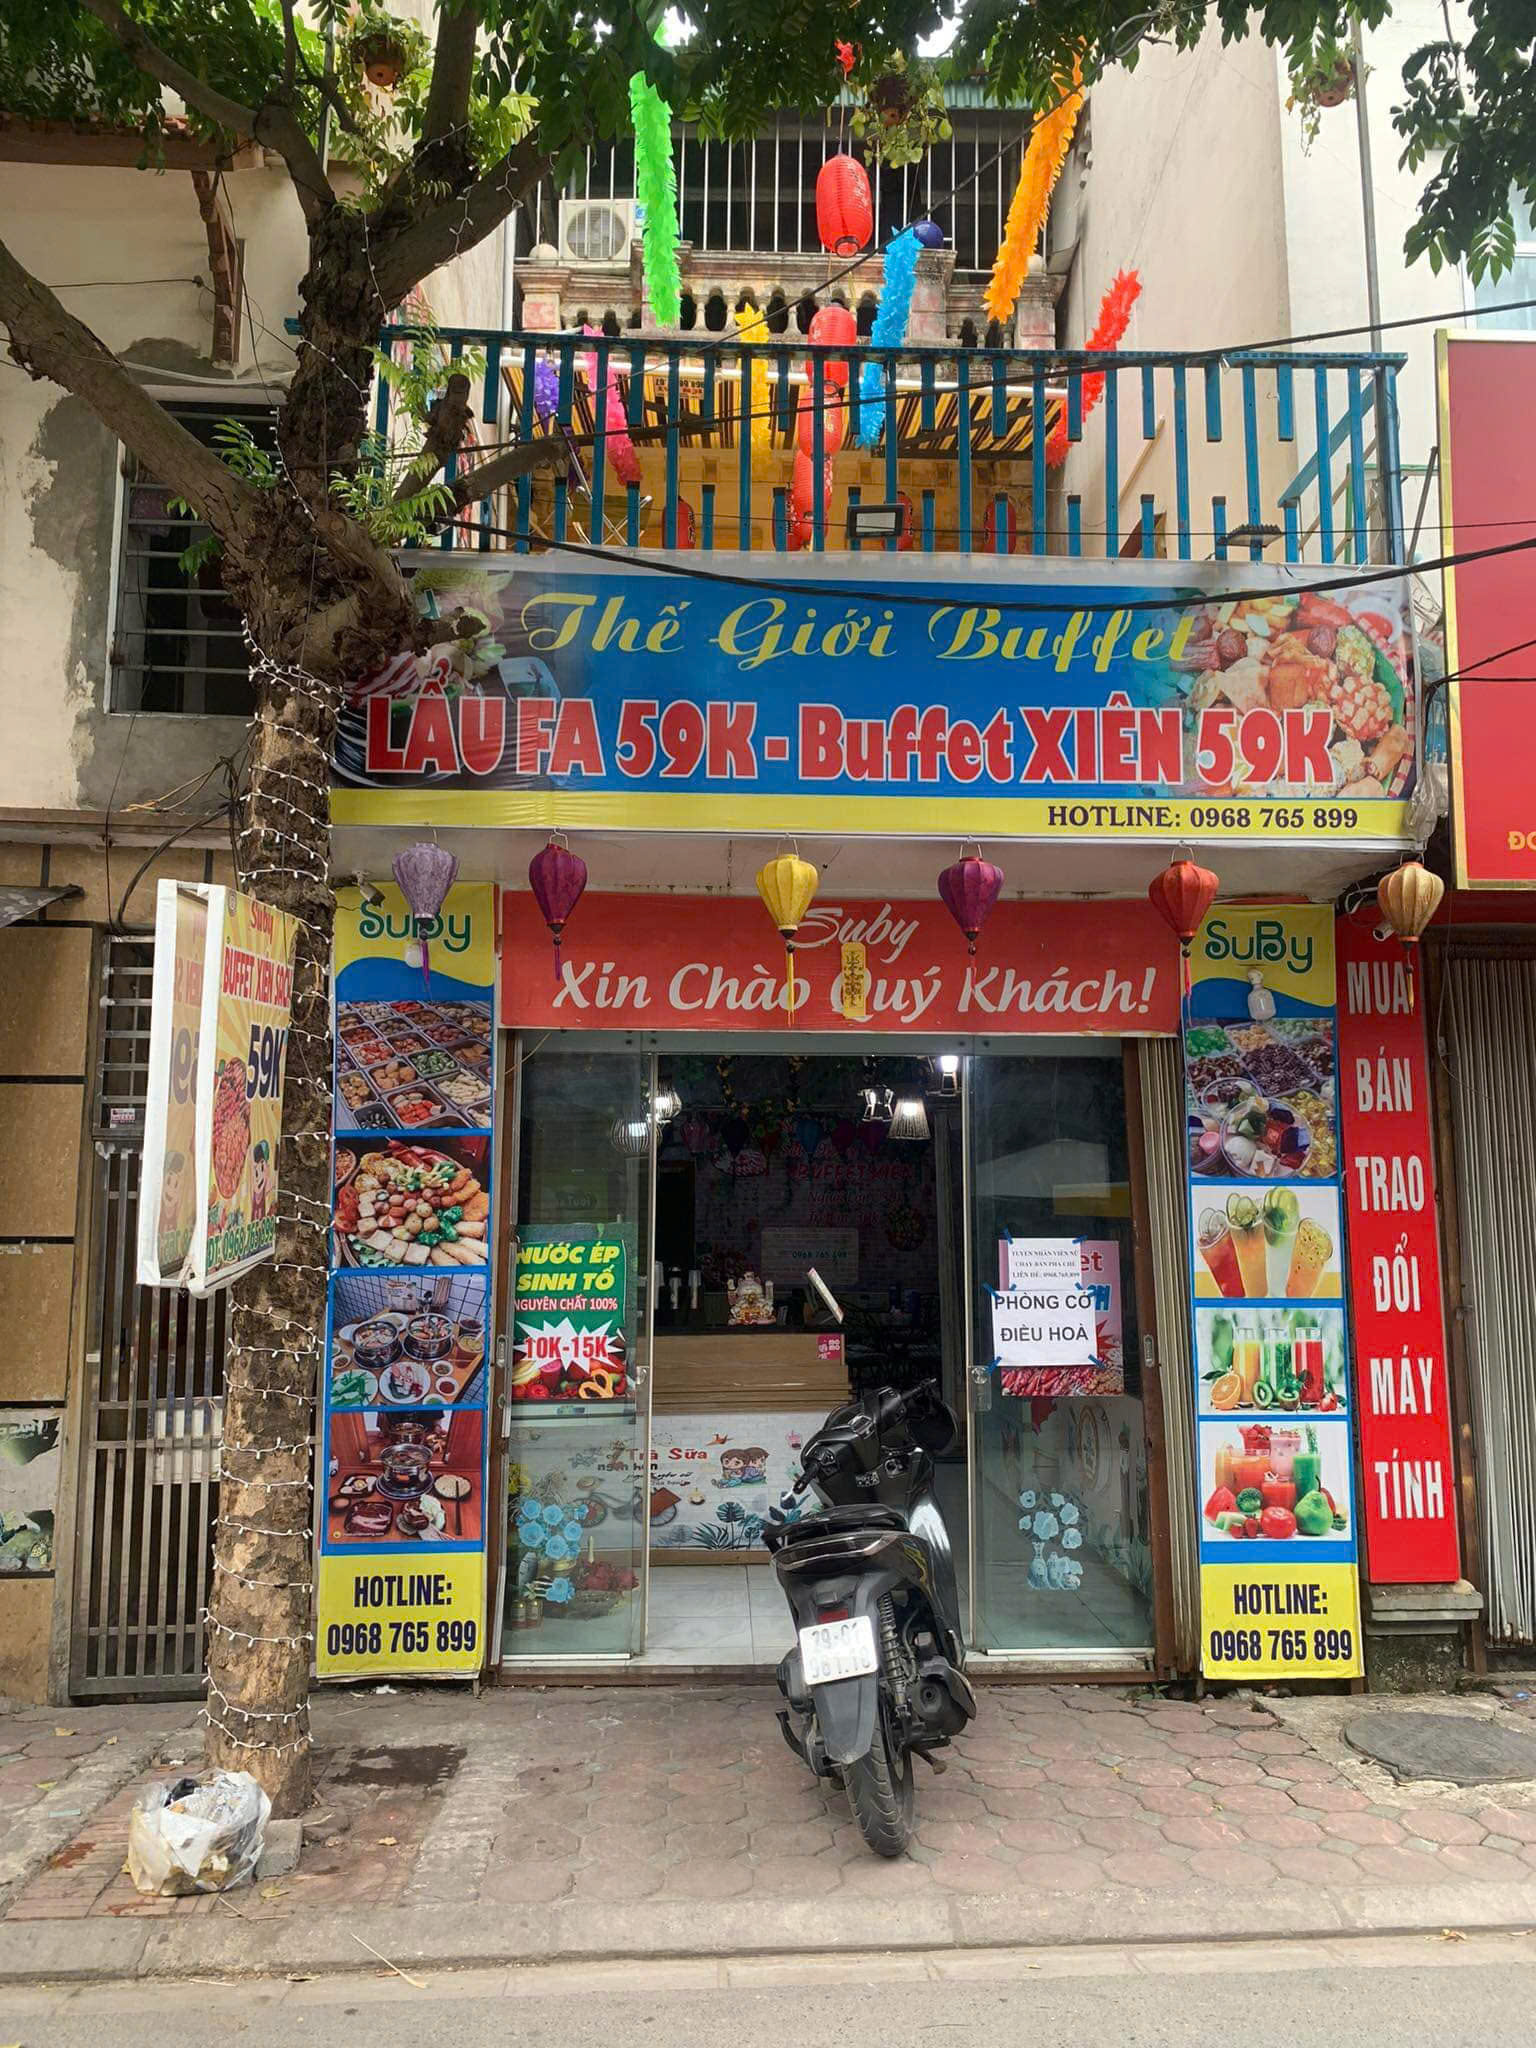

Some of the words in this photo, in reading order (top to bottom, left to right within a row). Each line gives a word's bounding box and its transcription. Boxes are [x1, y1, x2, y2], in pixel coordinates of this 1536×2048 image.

[519, 592, 693, 654] Thế
[709, 597, 898, 672] Giới
[928, 605, 1196, 674] Buffet
[365, 655, 507, 776] LẨU
[516, 695, 607, 777] FA
[614, 699, 759, 780] 59K
[798, 702, 1015, 783] Buffet
[1018, 690, 1184, 786] XIÊN
[1196, 706, 1335, 787] 59K
[1047, 805, 1182, 829] HOTLINE:
[1189, 807, 1252, 829] 0968
[1260, 808, 1305, 829] 765
[1312, 808, 1359, 830] 899
[790, 902, 919, 964] Suby
[1204, 919, 1313, 974] SuBy
[222, 946, 255, 999] BUFFET
[551, 959, 652, 1010] Xin
[668, 962, 811, 1012] Chào
[957, 966, 1158, 1015] Khách!
[1346, 961, 1411, 1015] MUA
[245, 1022, 287, 1100] 59K
[1356, 1046, 1413, 1112] BÁN
[1355, 1156, 1425, 1212] TRAO
[516, 1242, 585, 1265] NƯỚC
[589, 1241, 620, 1264] ÉP
[517, 1272, 578, 1291] SINH
[583, 1264, 616, 1291] TỐ
[1372, 1233, 1421, 1313] ĐỔI
[560, 1294, 587, 1311] CHẤT
[590, 1297, 618, 1311] 100%
[995, 1291, 1059, 1311] PHÒNG
[1065, 1291, 1091, 1310] CÓ
[525, 1335, 609, 1359] 10K-15K
[1000, 1323, 1043, 1342] ĐIỀU
[1050, 1322, 1089, 1341] HOÀ
[1370, 1346, 1433, 1416] MÁY
[633, 1462, 659, 1471] hn
[1374, 1450, 1445, 1519] TÍNH
[353, 1574, 452, 1608] HOTLINE:
[1233, 1583, 1328, 1615] HOTLINE:
[327, 1622, 382, 1656] 0968
[388, 1621, 430, 1653] 765
[436, 1620, 477, 1652] 899
[1210, 1630, 1262, 1661] 0968
[1267, 1630, 1307, 1661] 765
[1313, 1629, 1352, 1661] 899
